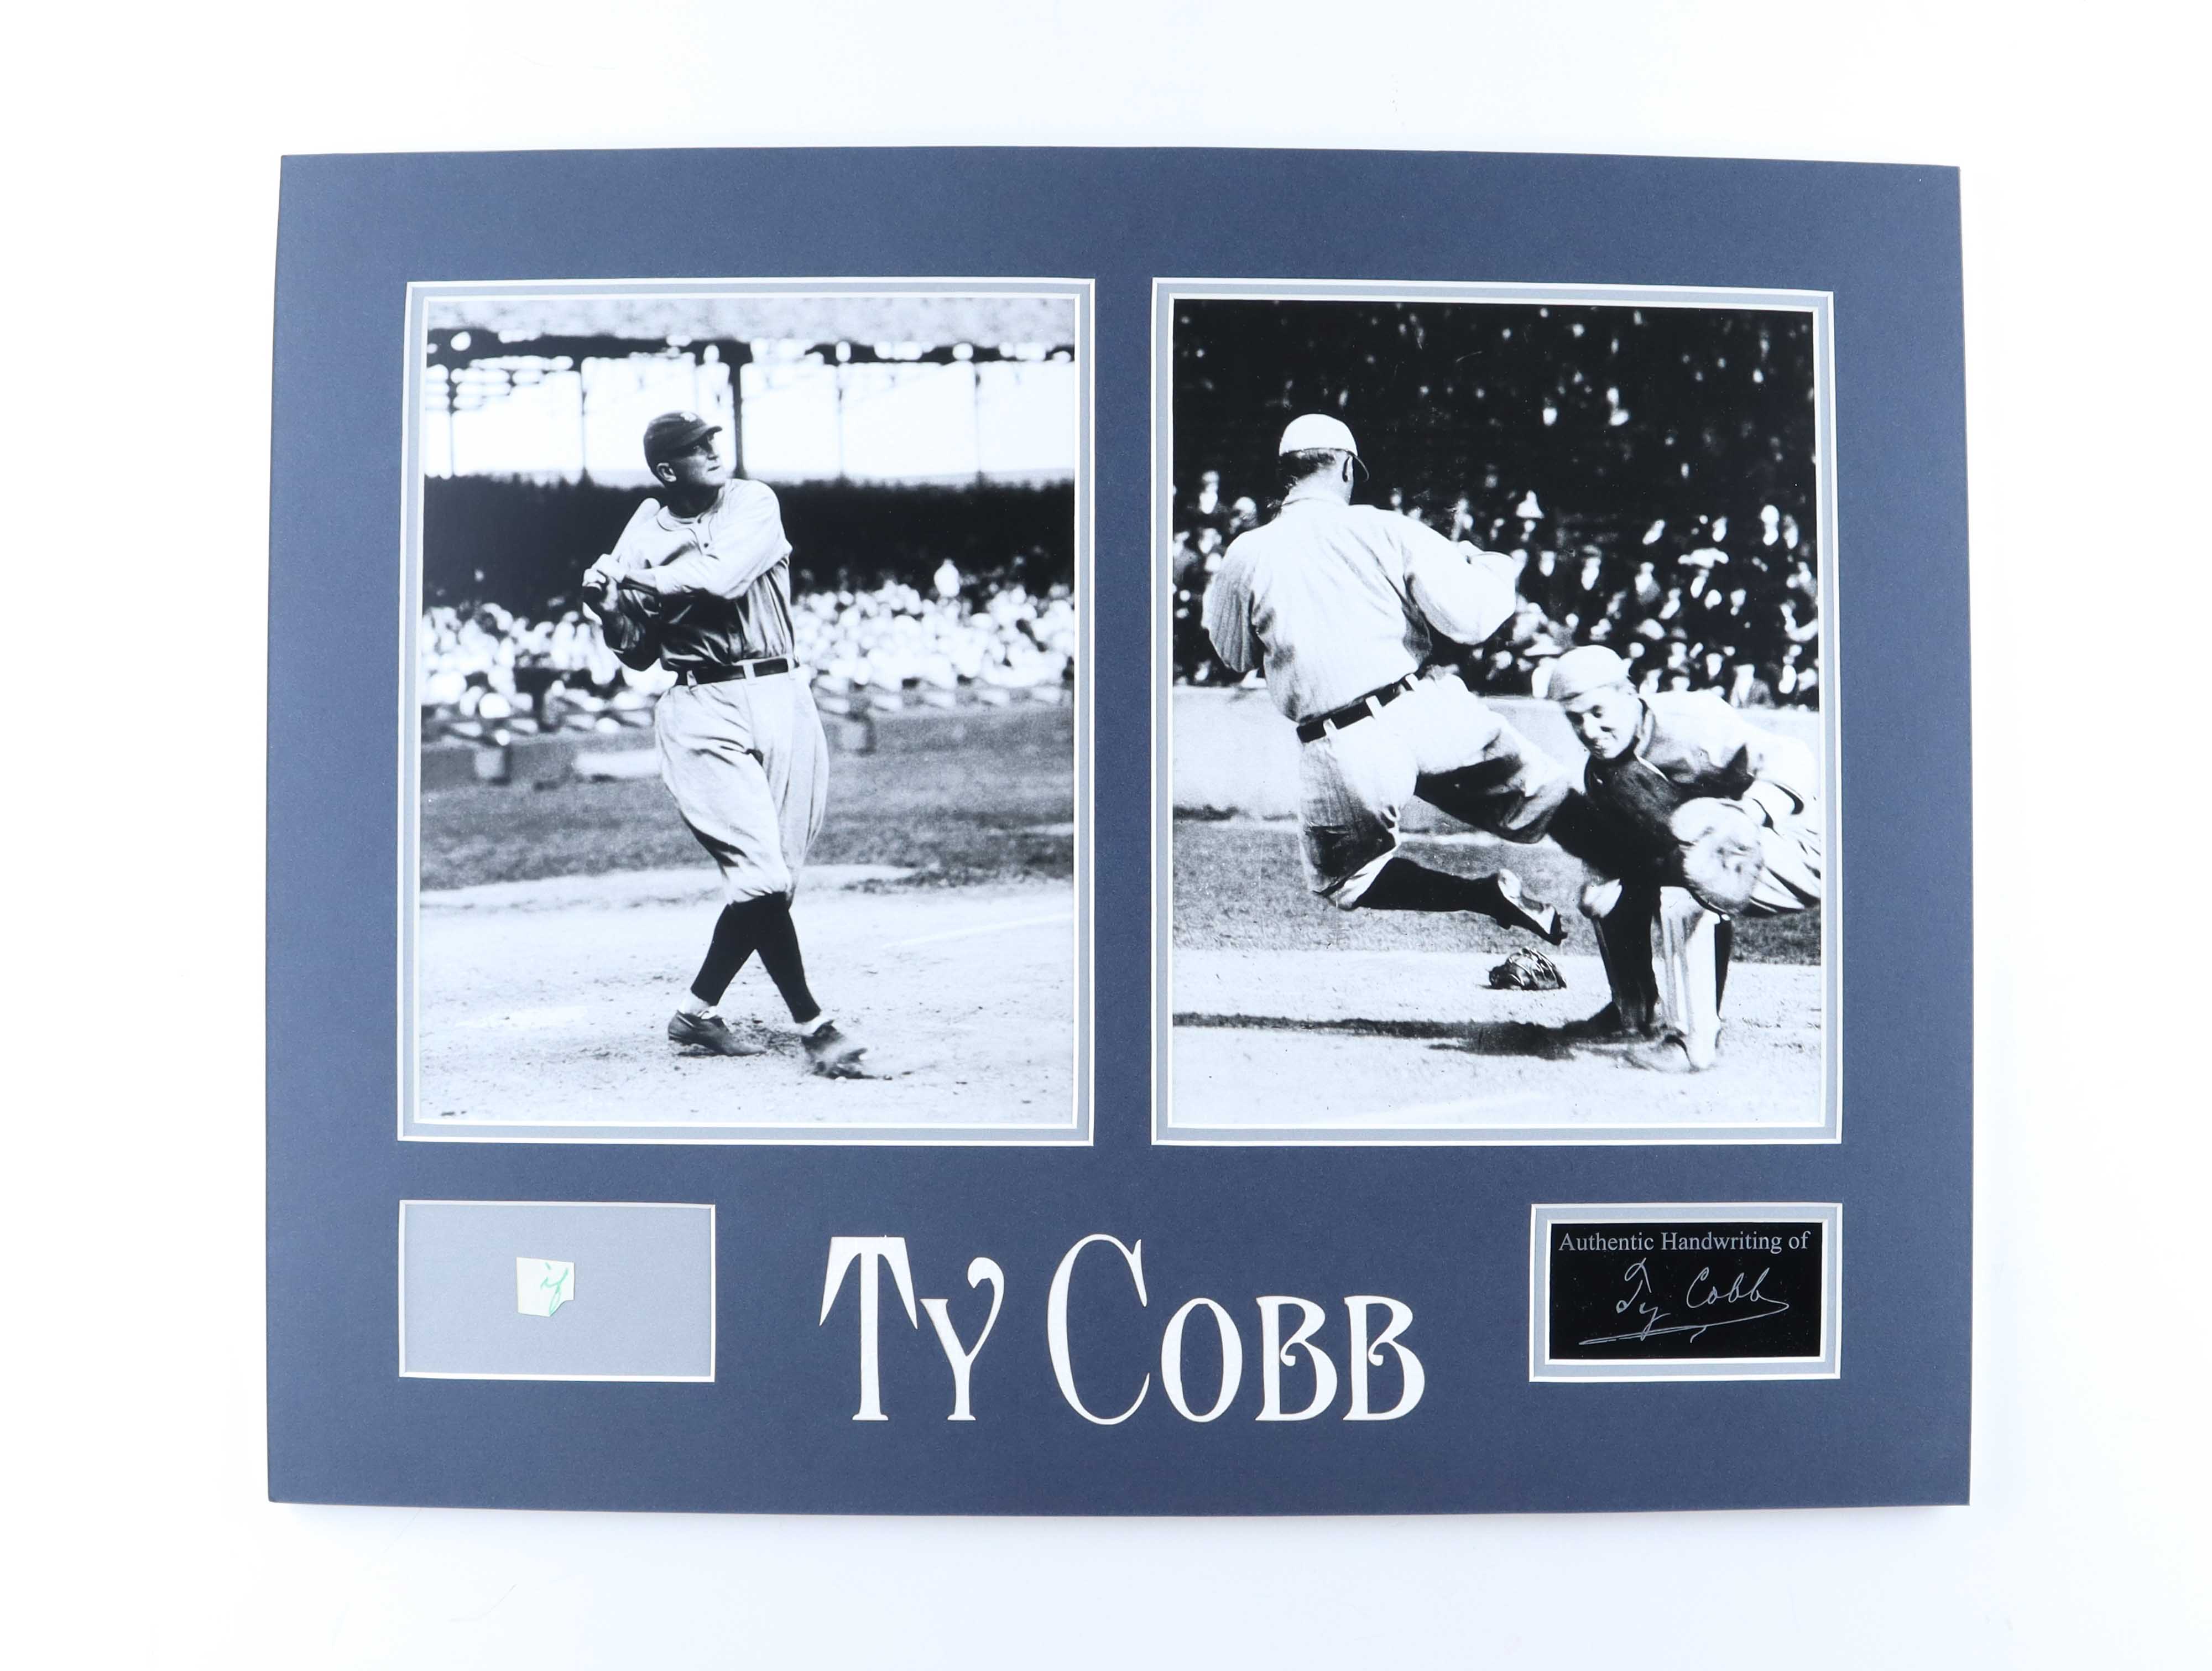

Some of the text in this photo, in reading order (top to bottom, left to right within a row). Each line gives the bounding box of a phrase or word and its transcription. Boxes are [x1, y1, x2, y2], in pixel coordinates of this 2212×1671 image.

[1558, 1230, 1812, 1254] Authentic Handwriting of
[1615, 1257, 1790, 1341] Ty Cobb
